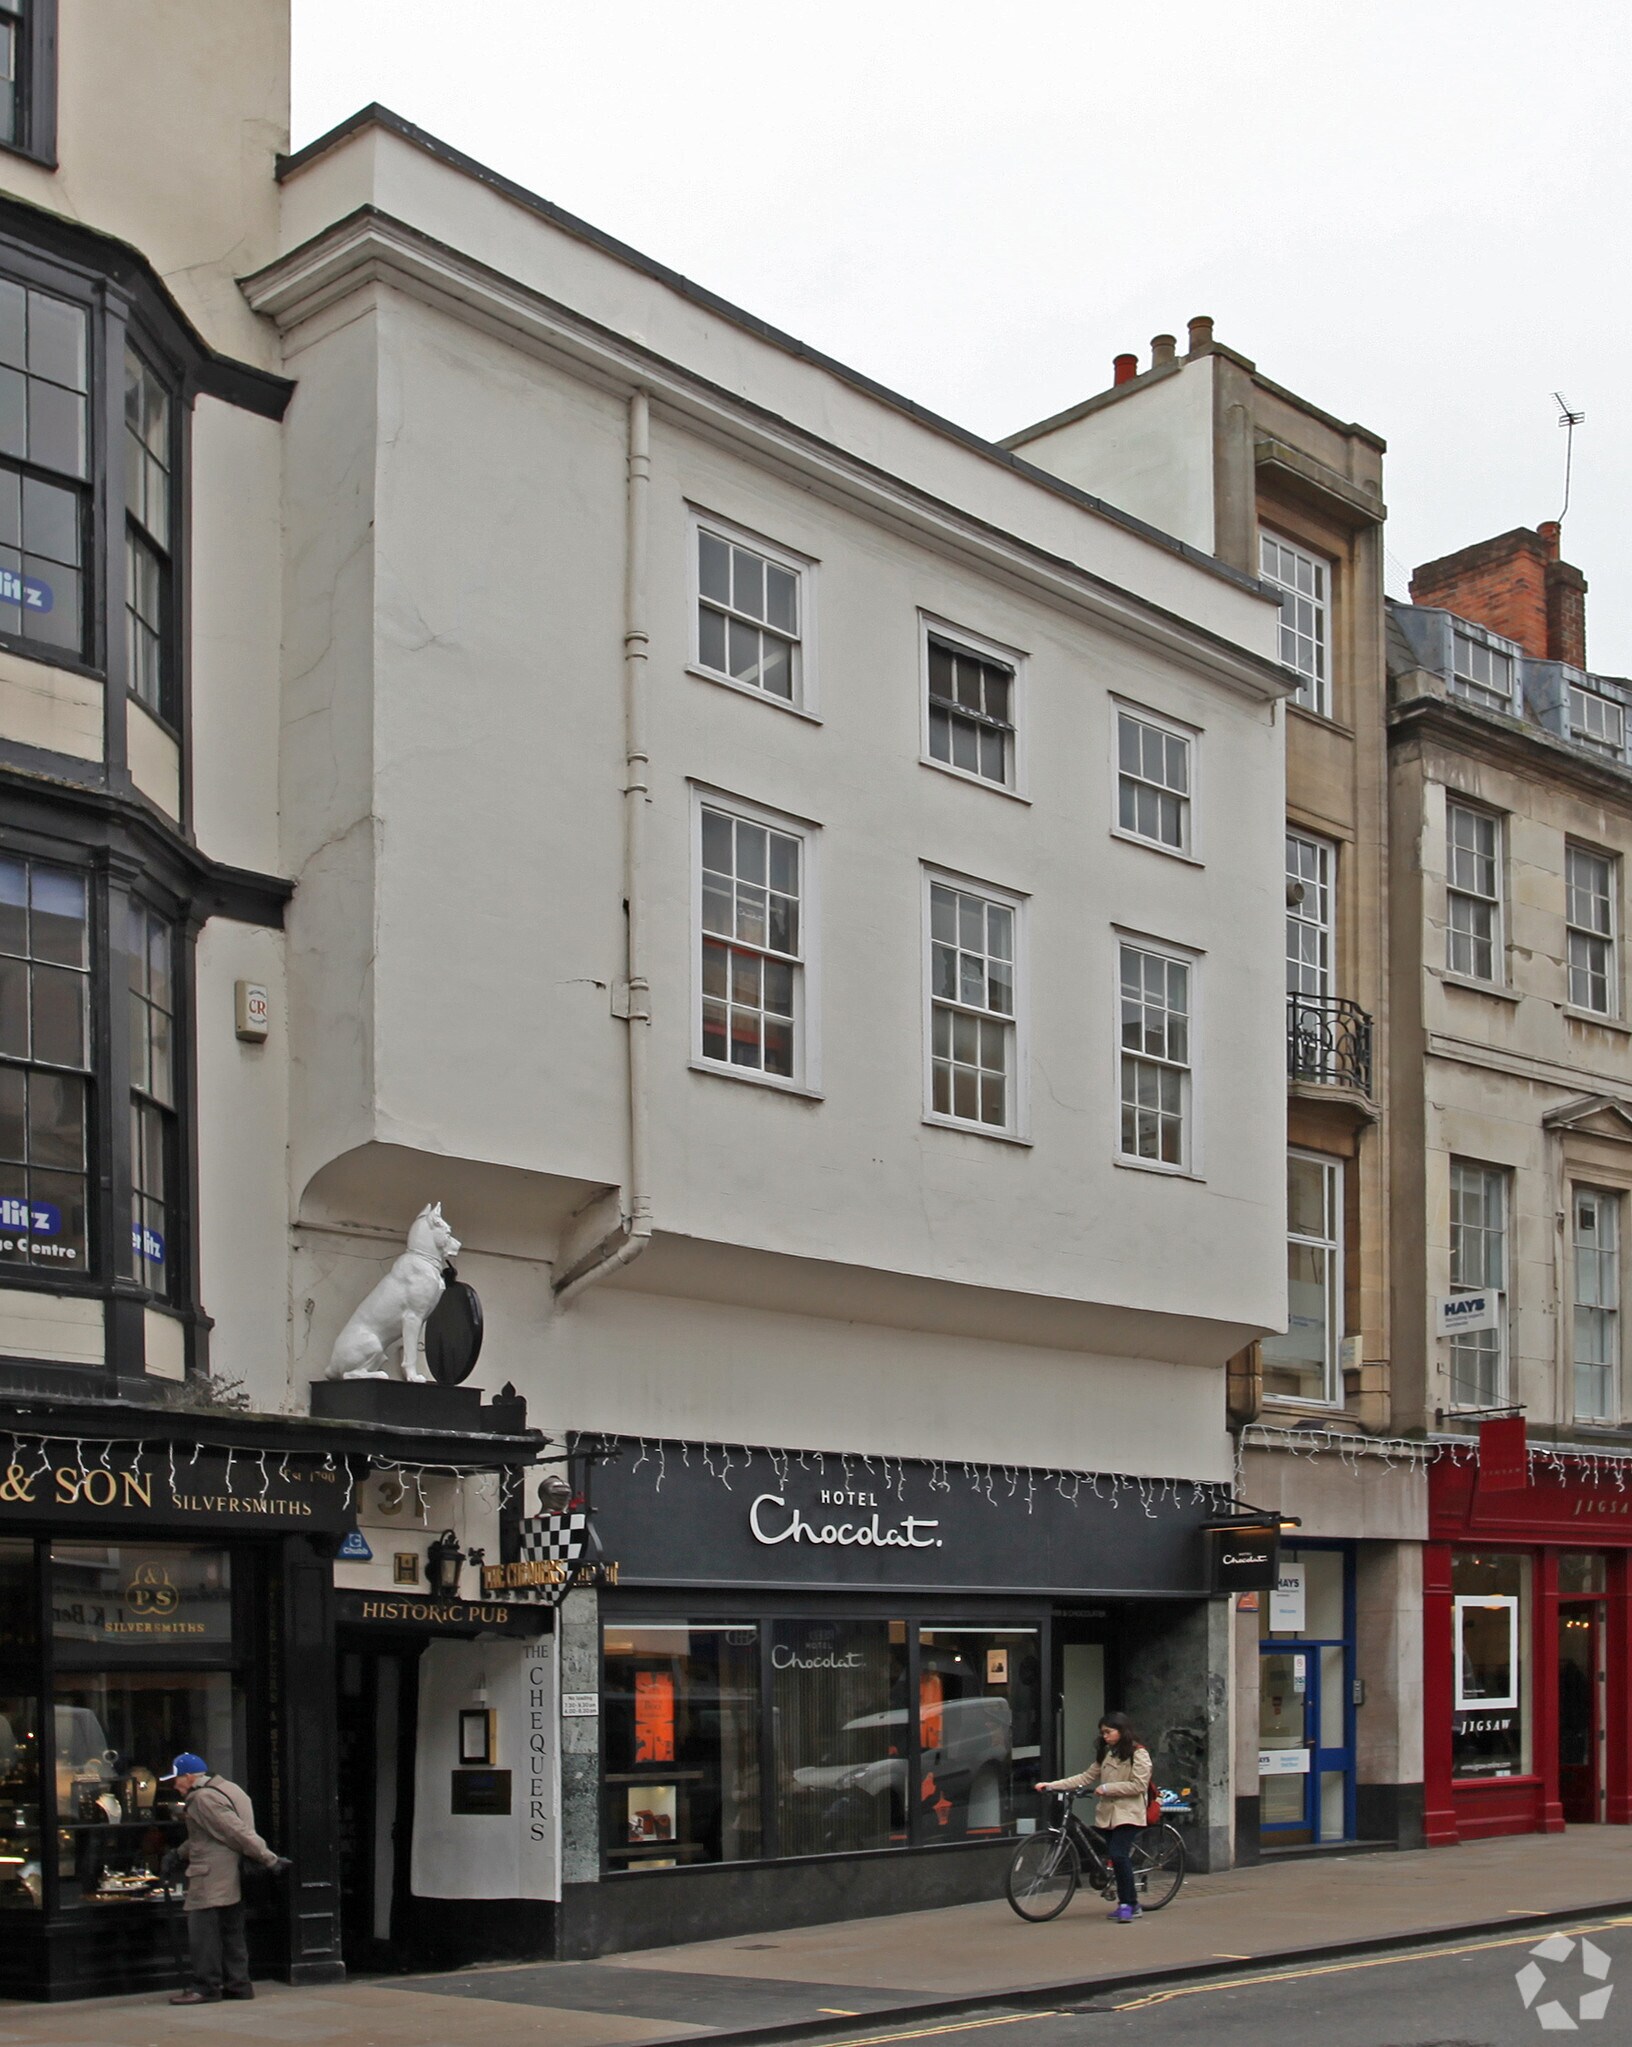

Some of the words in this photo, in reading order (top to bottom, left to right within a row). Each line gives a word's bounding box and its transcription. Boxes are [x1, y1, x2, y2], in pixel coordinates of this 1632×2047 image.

[249, 999, 266, 1016] CR
[17, 1238, 77, 1259] Centre
[1445, 1298, 1485, 1316] HAYS
[0, 1464, 36, 1502] &
[55, 1467, 152, 1508] SON
[172, 1494, 312, 1516] SILVERSMITHS
[821, 1490, 878, 1507] HOTEL
[469, 1606, 509, 1623] PUB
[105, 1622, 206, 1633] SILVERSMITHS
[524, 1645, 549, 1658] THE
[1460, 1719, 1511, 1735] JIGSAW
[530, 1667, 547, 1841] CHEQUERS
